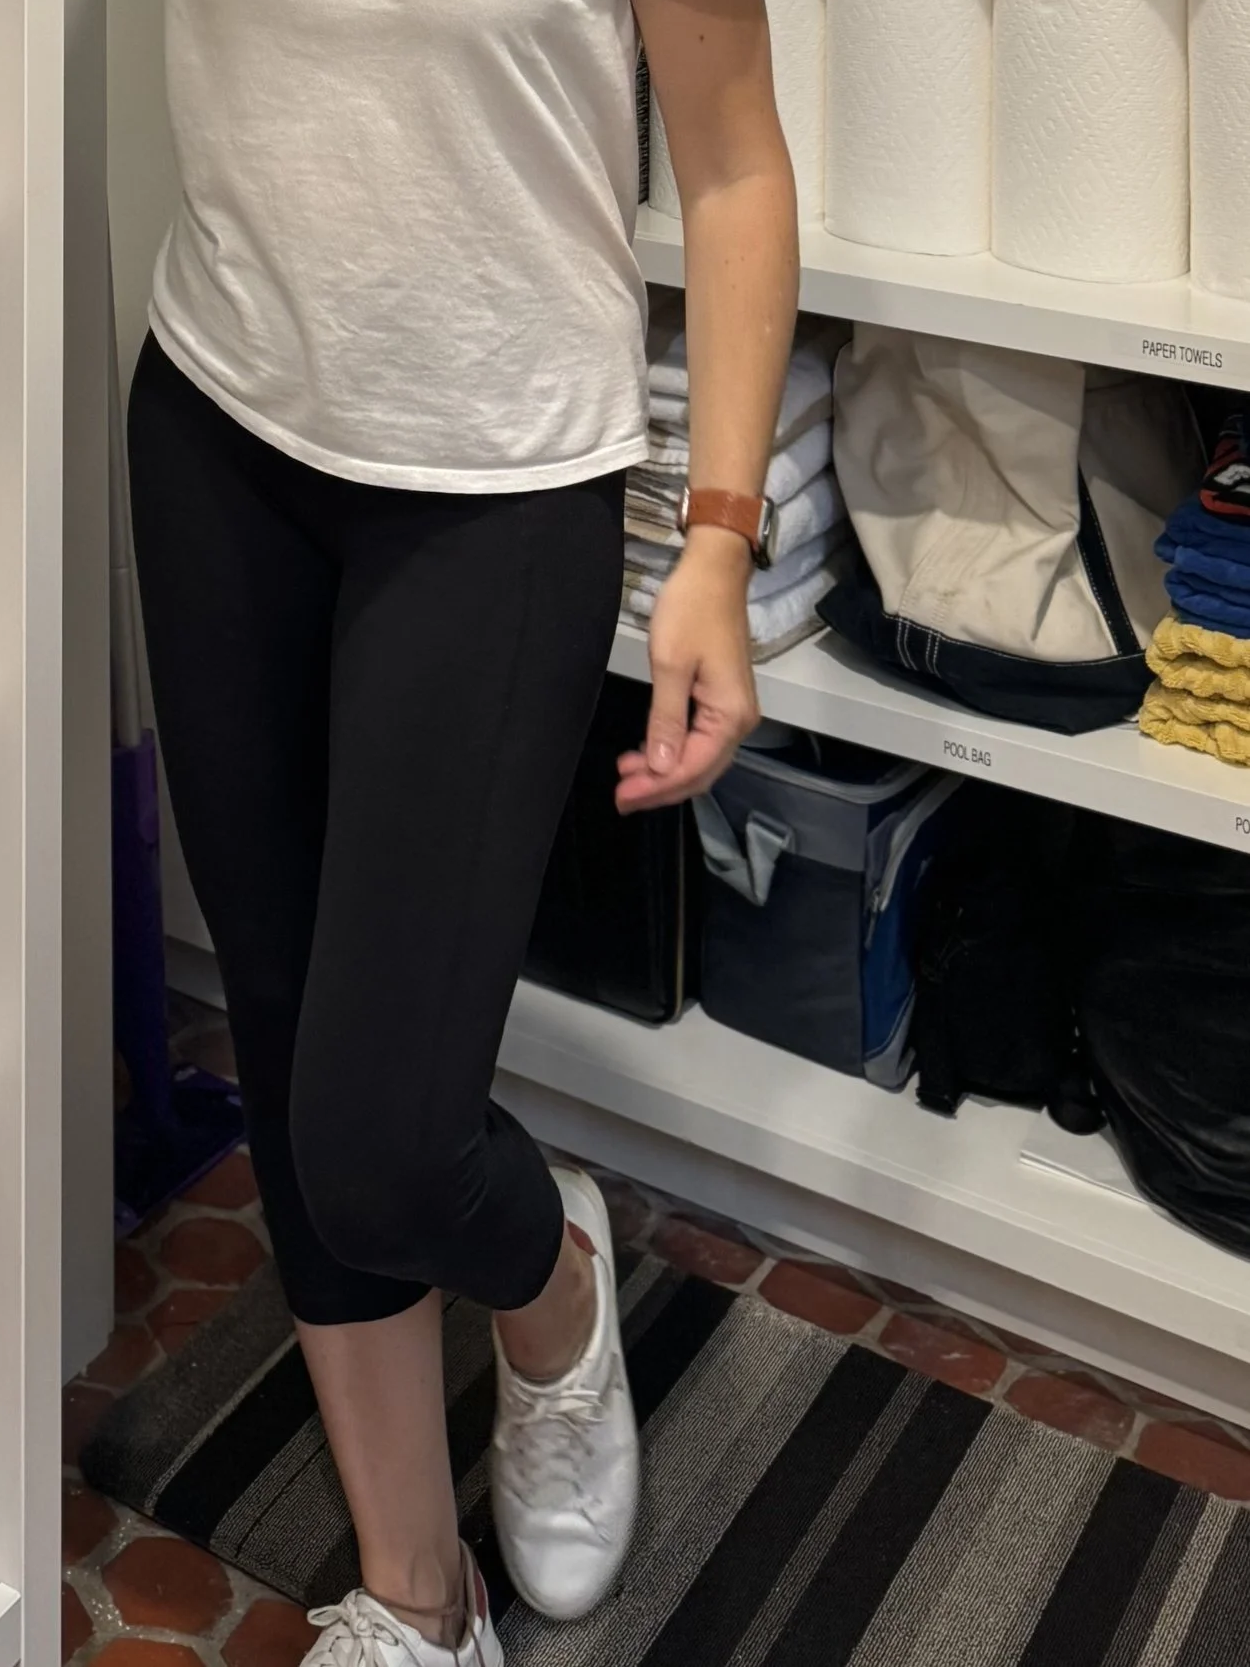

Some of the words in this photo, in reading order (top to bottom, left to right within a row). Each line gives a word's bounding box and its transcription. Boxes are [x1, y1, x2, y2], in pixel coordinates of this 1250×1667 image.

[1142, 339, 1177, 362] PAPER
[1178, 345, 1223, 369] TOWELS
[943, 740, 969, 761] POOL
[971, 747, 992, 767] BAG
